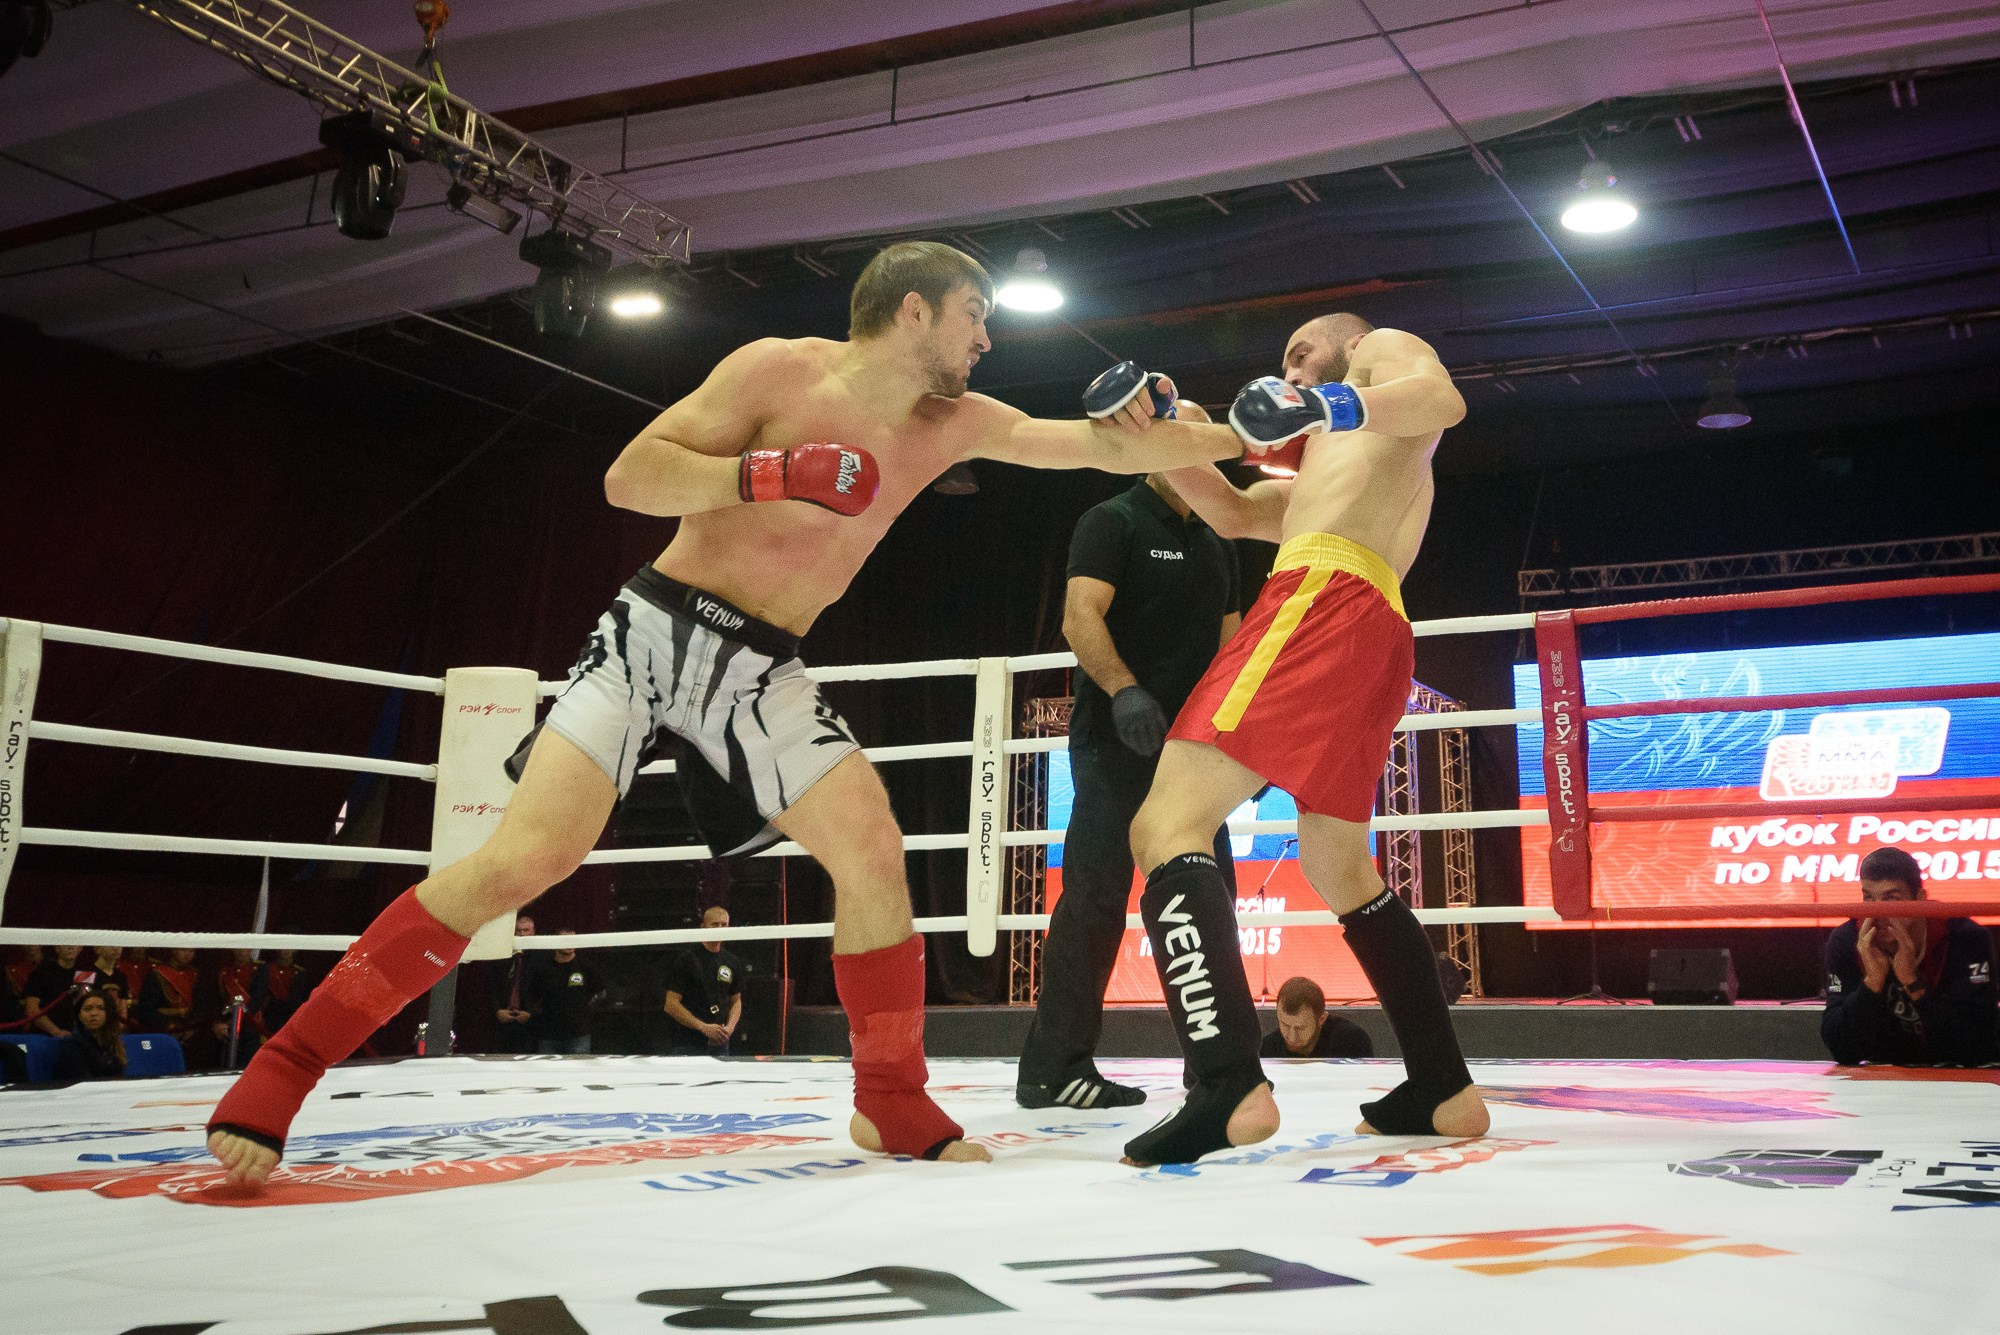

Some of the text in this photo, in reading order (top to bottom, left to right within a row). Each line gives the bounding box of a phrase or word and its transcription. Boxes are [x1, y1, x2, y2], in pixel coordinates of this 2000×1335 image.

[1150, 549, 1184, 560] СУДЬЯ
[695, 596, 745, 630] VENUM
[459, 704, 482, 713] РЭЙ
[452, 803, 474, 813] РЭЙ
[1710, 818, 1839, 853] кубок
[1182, 855, 1218, 869] VENUM
[1714, 861, 1770, 885] по
[1781, 854, 1861, 883] ММ
[1361, 890, 1394, 915] VENUM
[1157, 893, 1221, 1042] VENUM
